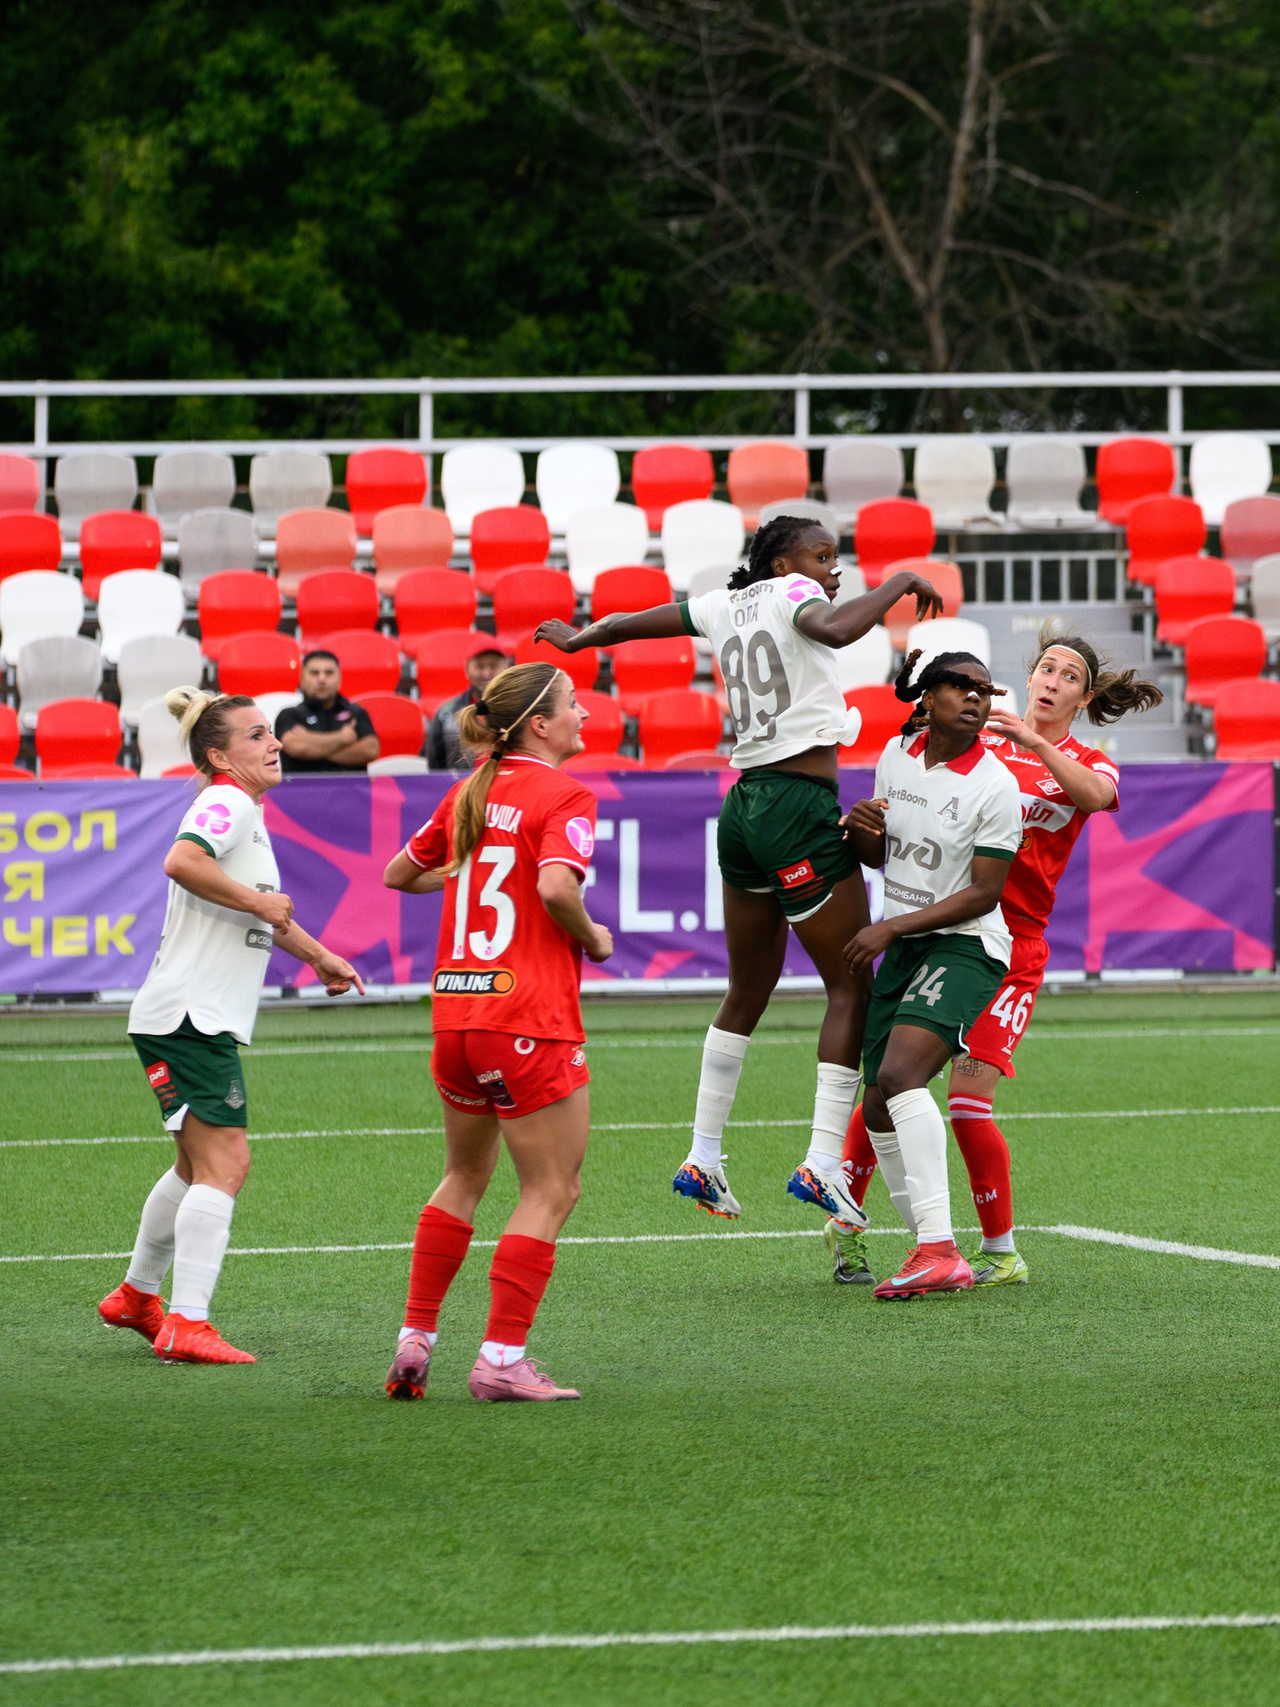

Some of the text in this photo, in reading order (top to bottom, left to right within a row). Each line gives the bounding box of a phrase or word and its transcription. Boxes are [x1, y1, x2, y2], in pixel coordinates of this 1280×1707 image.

[720, 629, 791, 742] 89
[449, 845, 516, 961] 13
[435, 971, 495, 992] WINLINE
[901, 964, 948, 1007] 24
[989, 984, 1033, 1035] 46
